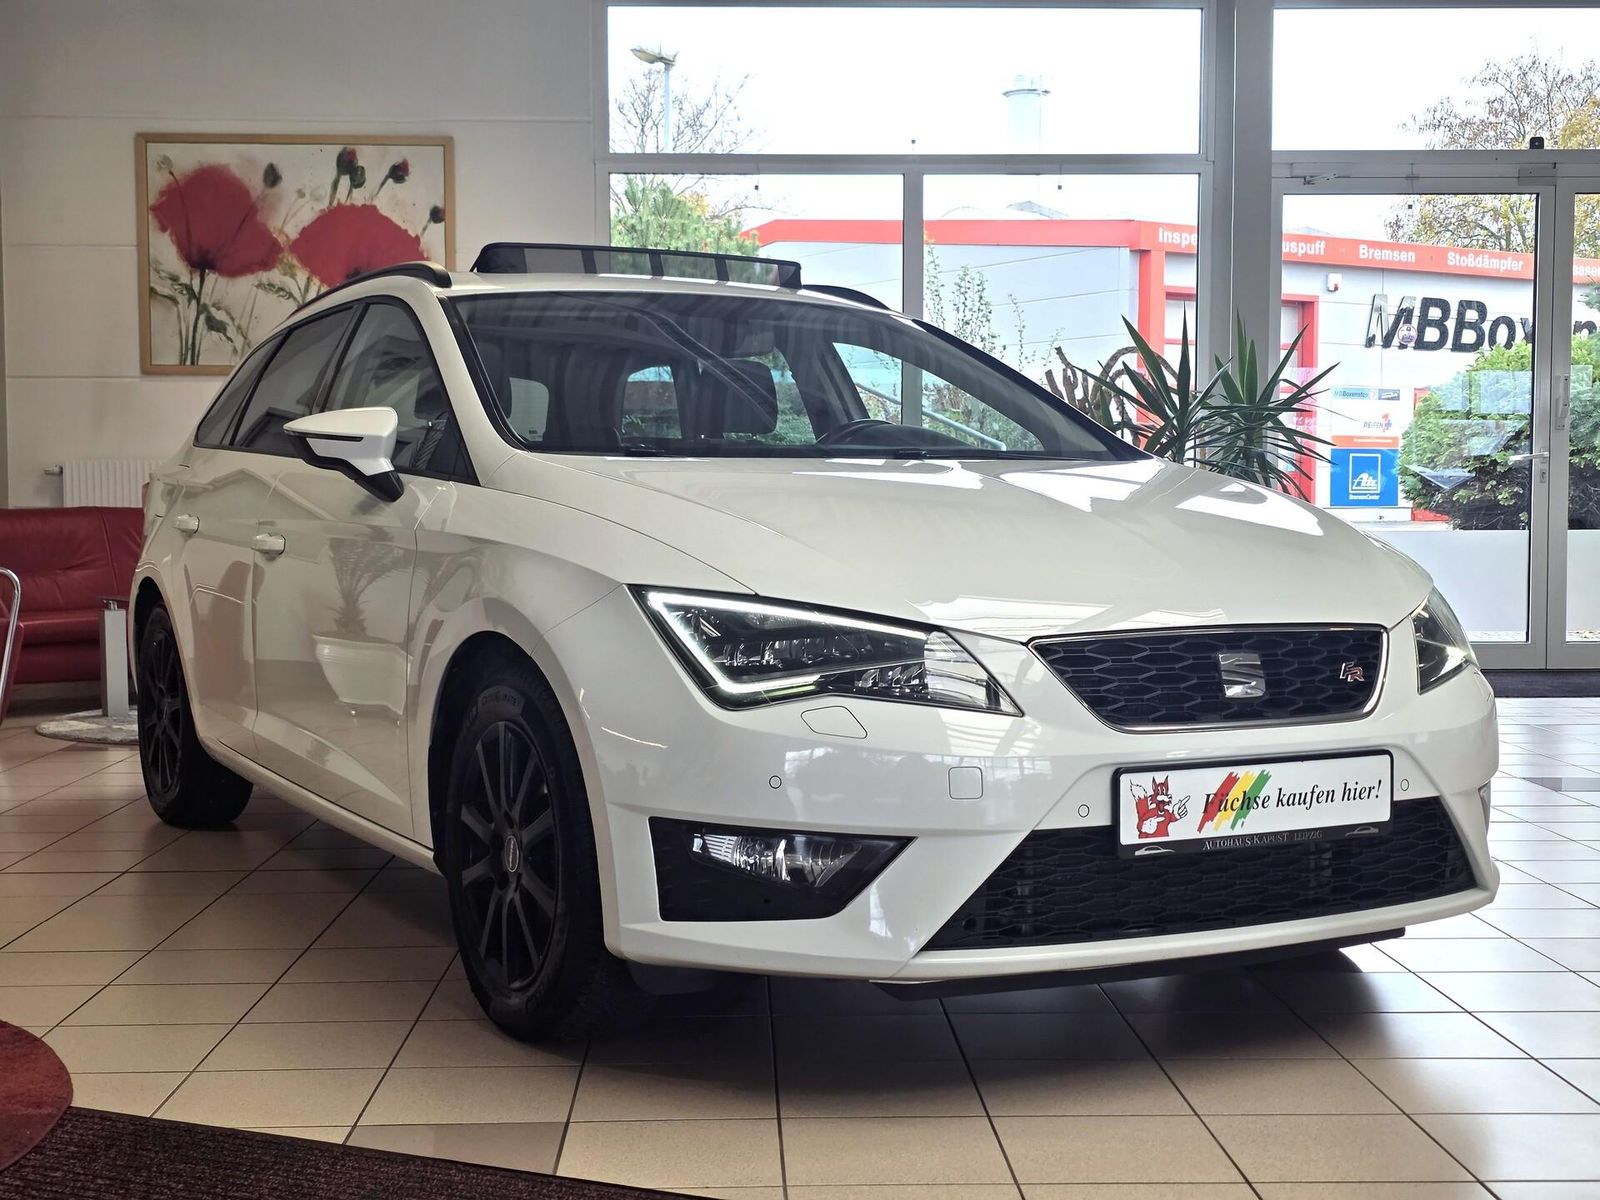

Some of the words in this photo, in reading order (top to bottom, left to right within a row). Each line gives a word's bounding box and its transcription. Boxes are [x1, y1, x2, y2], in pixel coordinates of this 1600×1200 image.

[1158, 227, 1198, 248] Inspe
[1282, 240, 1326, 256] uspuff
[1359, 244, 1416, 263] Bremsen
[1447, 252, 1524, 272] Stoßdämpfer
[1340, 661, 1365, 682] FR
[1276, 784, 1336, 811] kaufen
[1341, 779, 1382, 802] hier!
